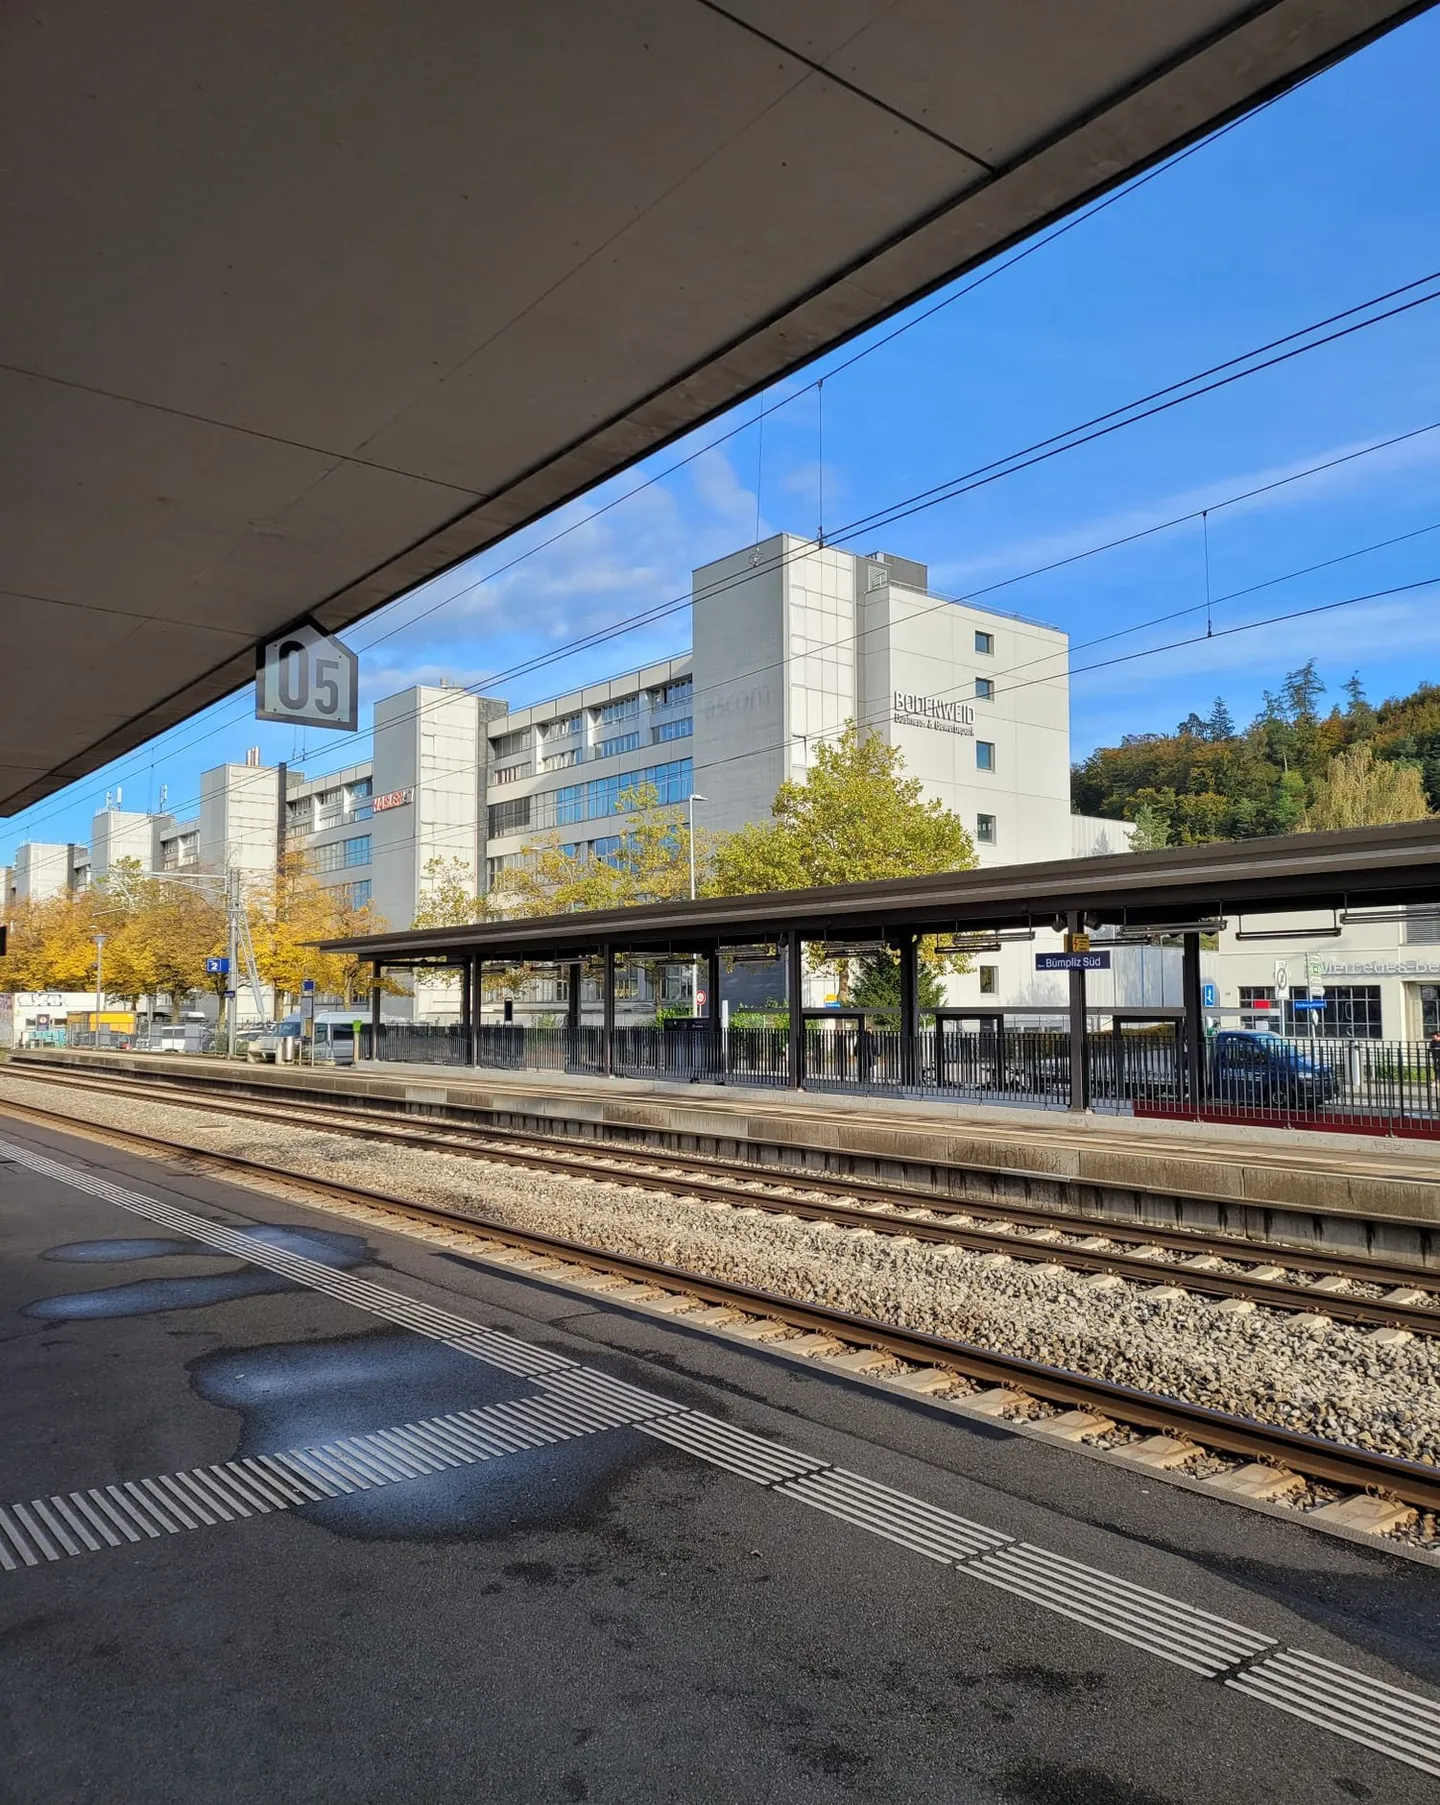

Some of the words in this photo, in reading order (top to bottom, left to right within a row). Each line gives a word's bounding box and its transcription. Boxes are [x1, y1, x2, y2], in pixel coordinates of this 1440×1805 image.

[894, 691, 975, 725] BODENWEID
[211, 962, 218, 970] 2
[1045, 957, 1081, 969] Bümpliz
[1082, 956, 1101, 967] Süd
